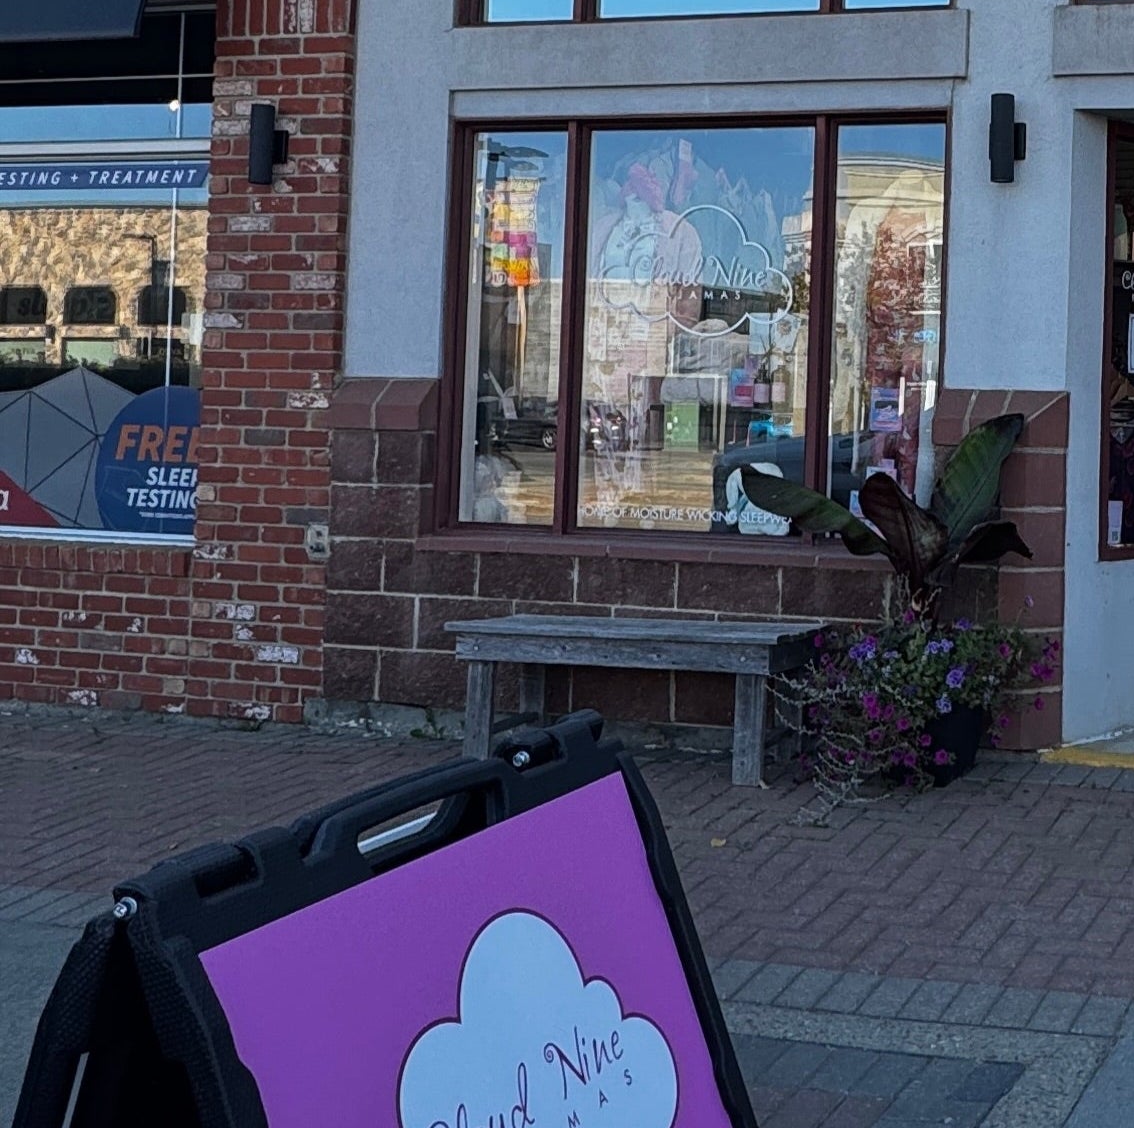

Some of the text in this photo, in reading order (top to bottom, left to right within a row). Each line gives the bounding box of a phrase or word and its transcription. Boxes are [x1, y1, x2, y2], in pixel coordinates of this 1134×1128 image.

[88, 169, 198, 185] TREATMENT
[708, 256, 767, 288] Nine
[612, 507, 627, 519] OF
[631, 507, 683, 521] MOISTURE
[685, 509, 737, 523] WICKING
[543, 1025, 624, 1101] Nine
